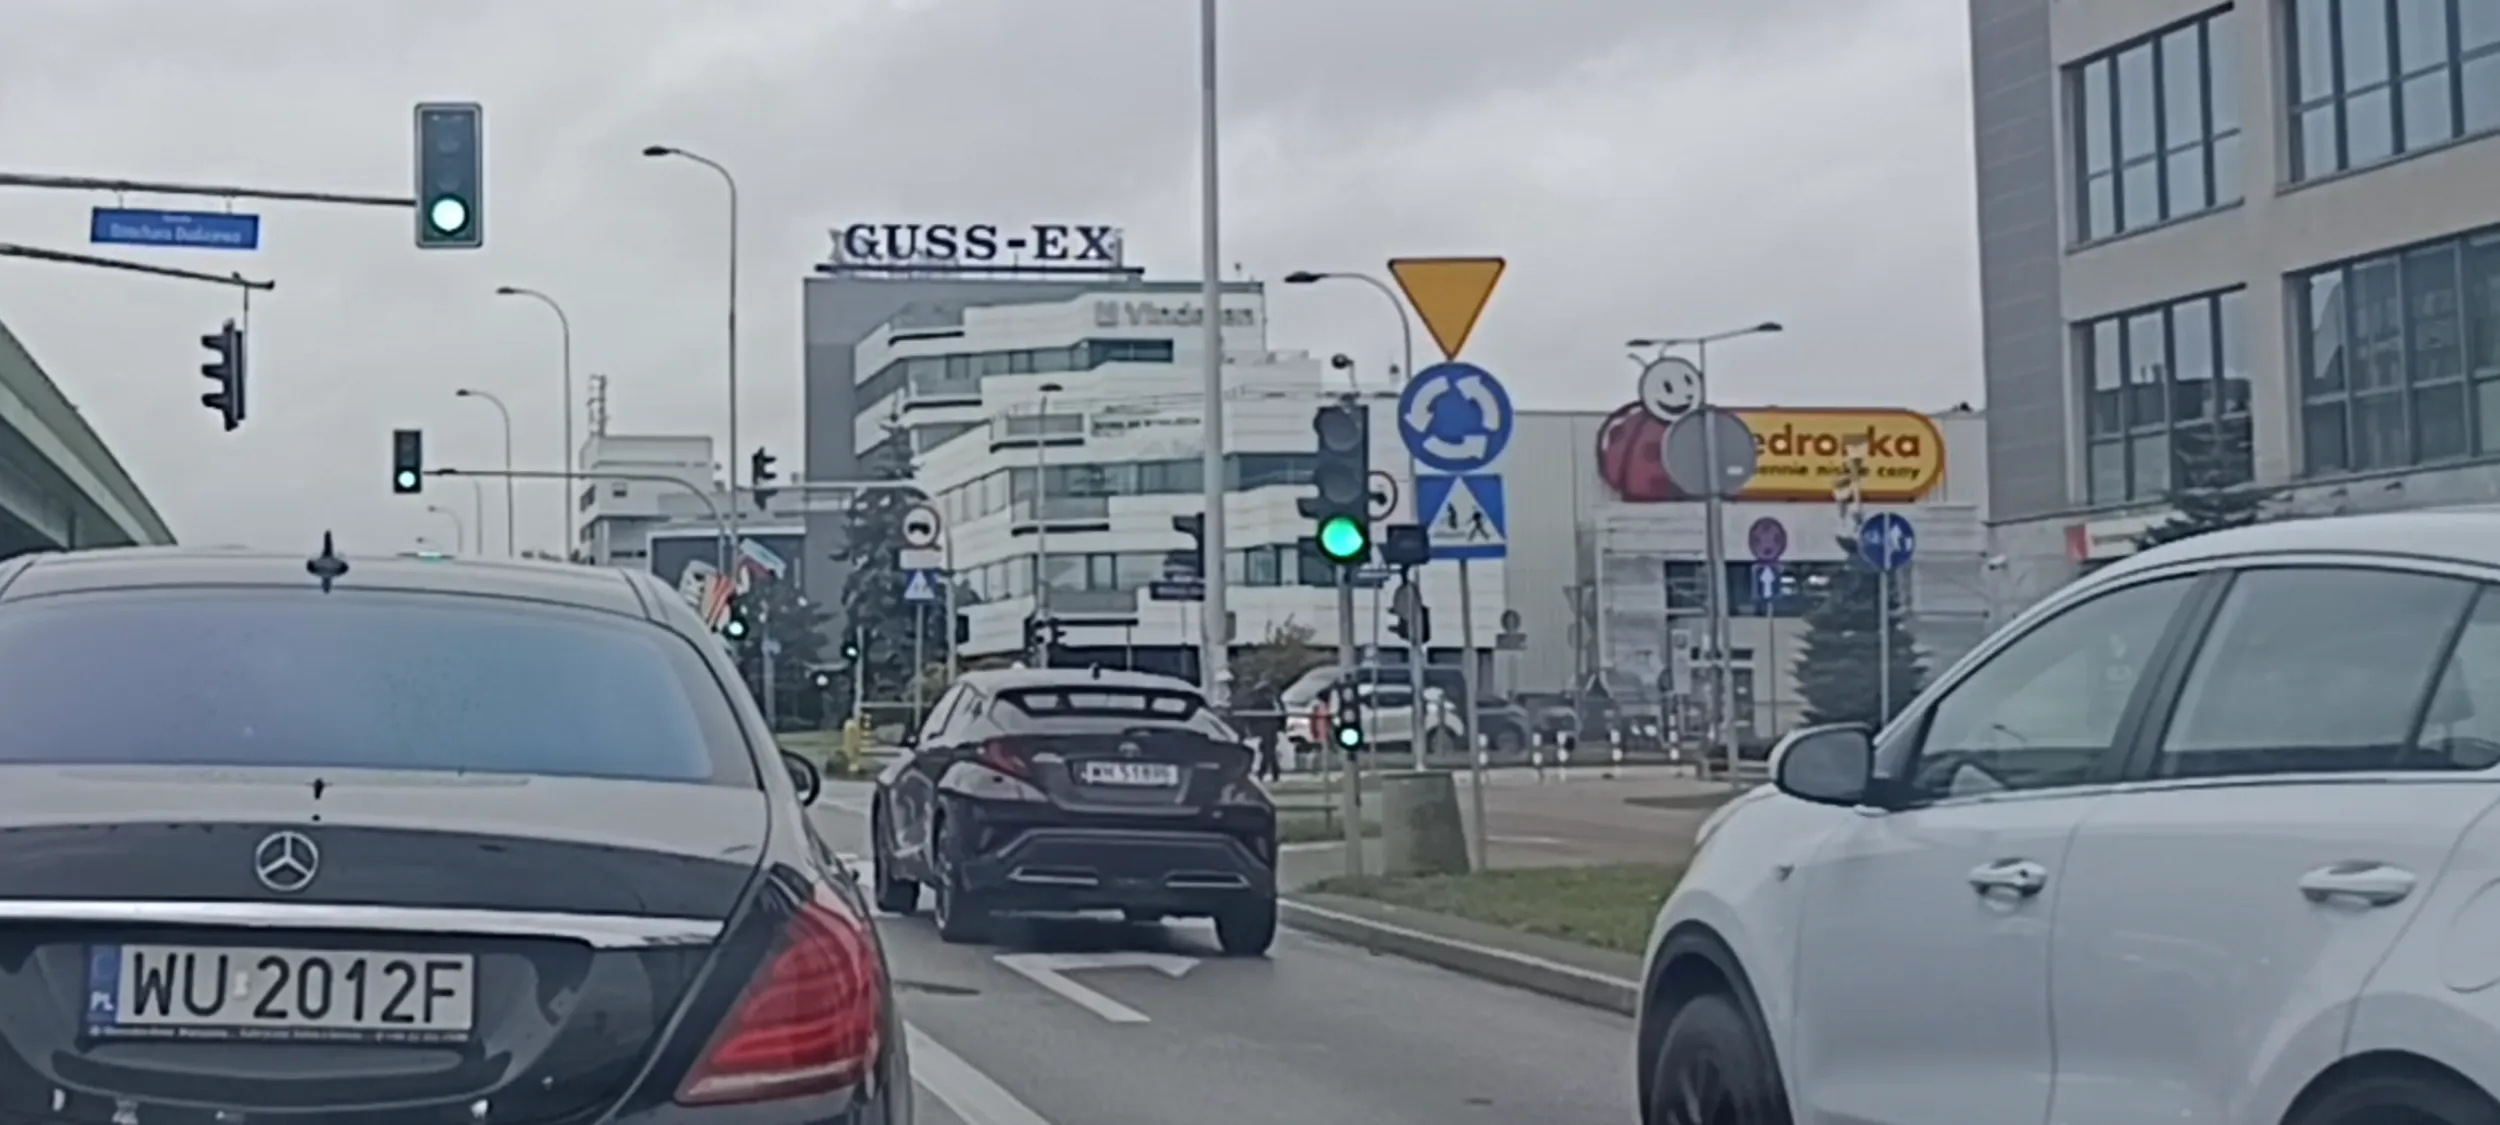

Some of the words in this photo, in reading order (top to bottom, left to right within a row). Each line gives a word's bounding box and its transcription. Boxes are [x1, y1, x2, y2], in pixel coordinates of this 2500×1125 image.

[844, 224, 1113, 260] GUSS-EX
[91, 992, 114, 1011] PL
[133, 952, 229, 1017] WU
[252, 955, 464, 1024] 2012F
